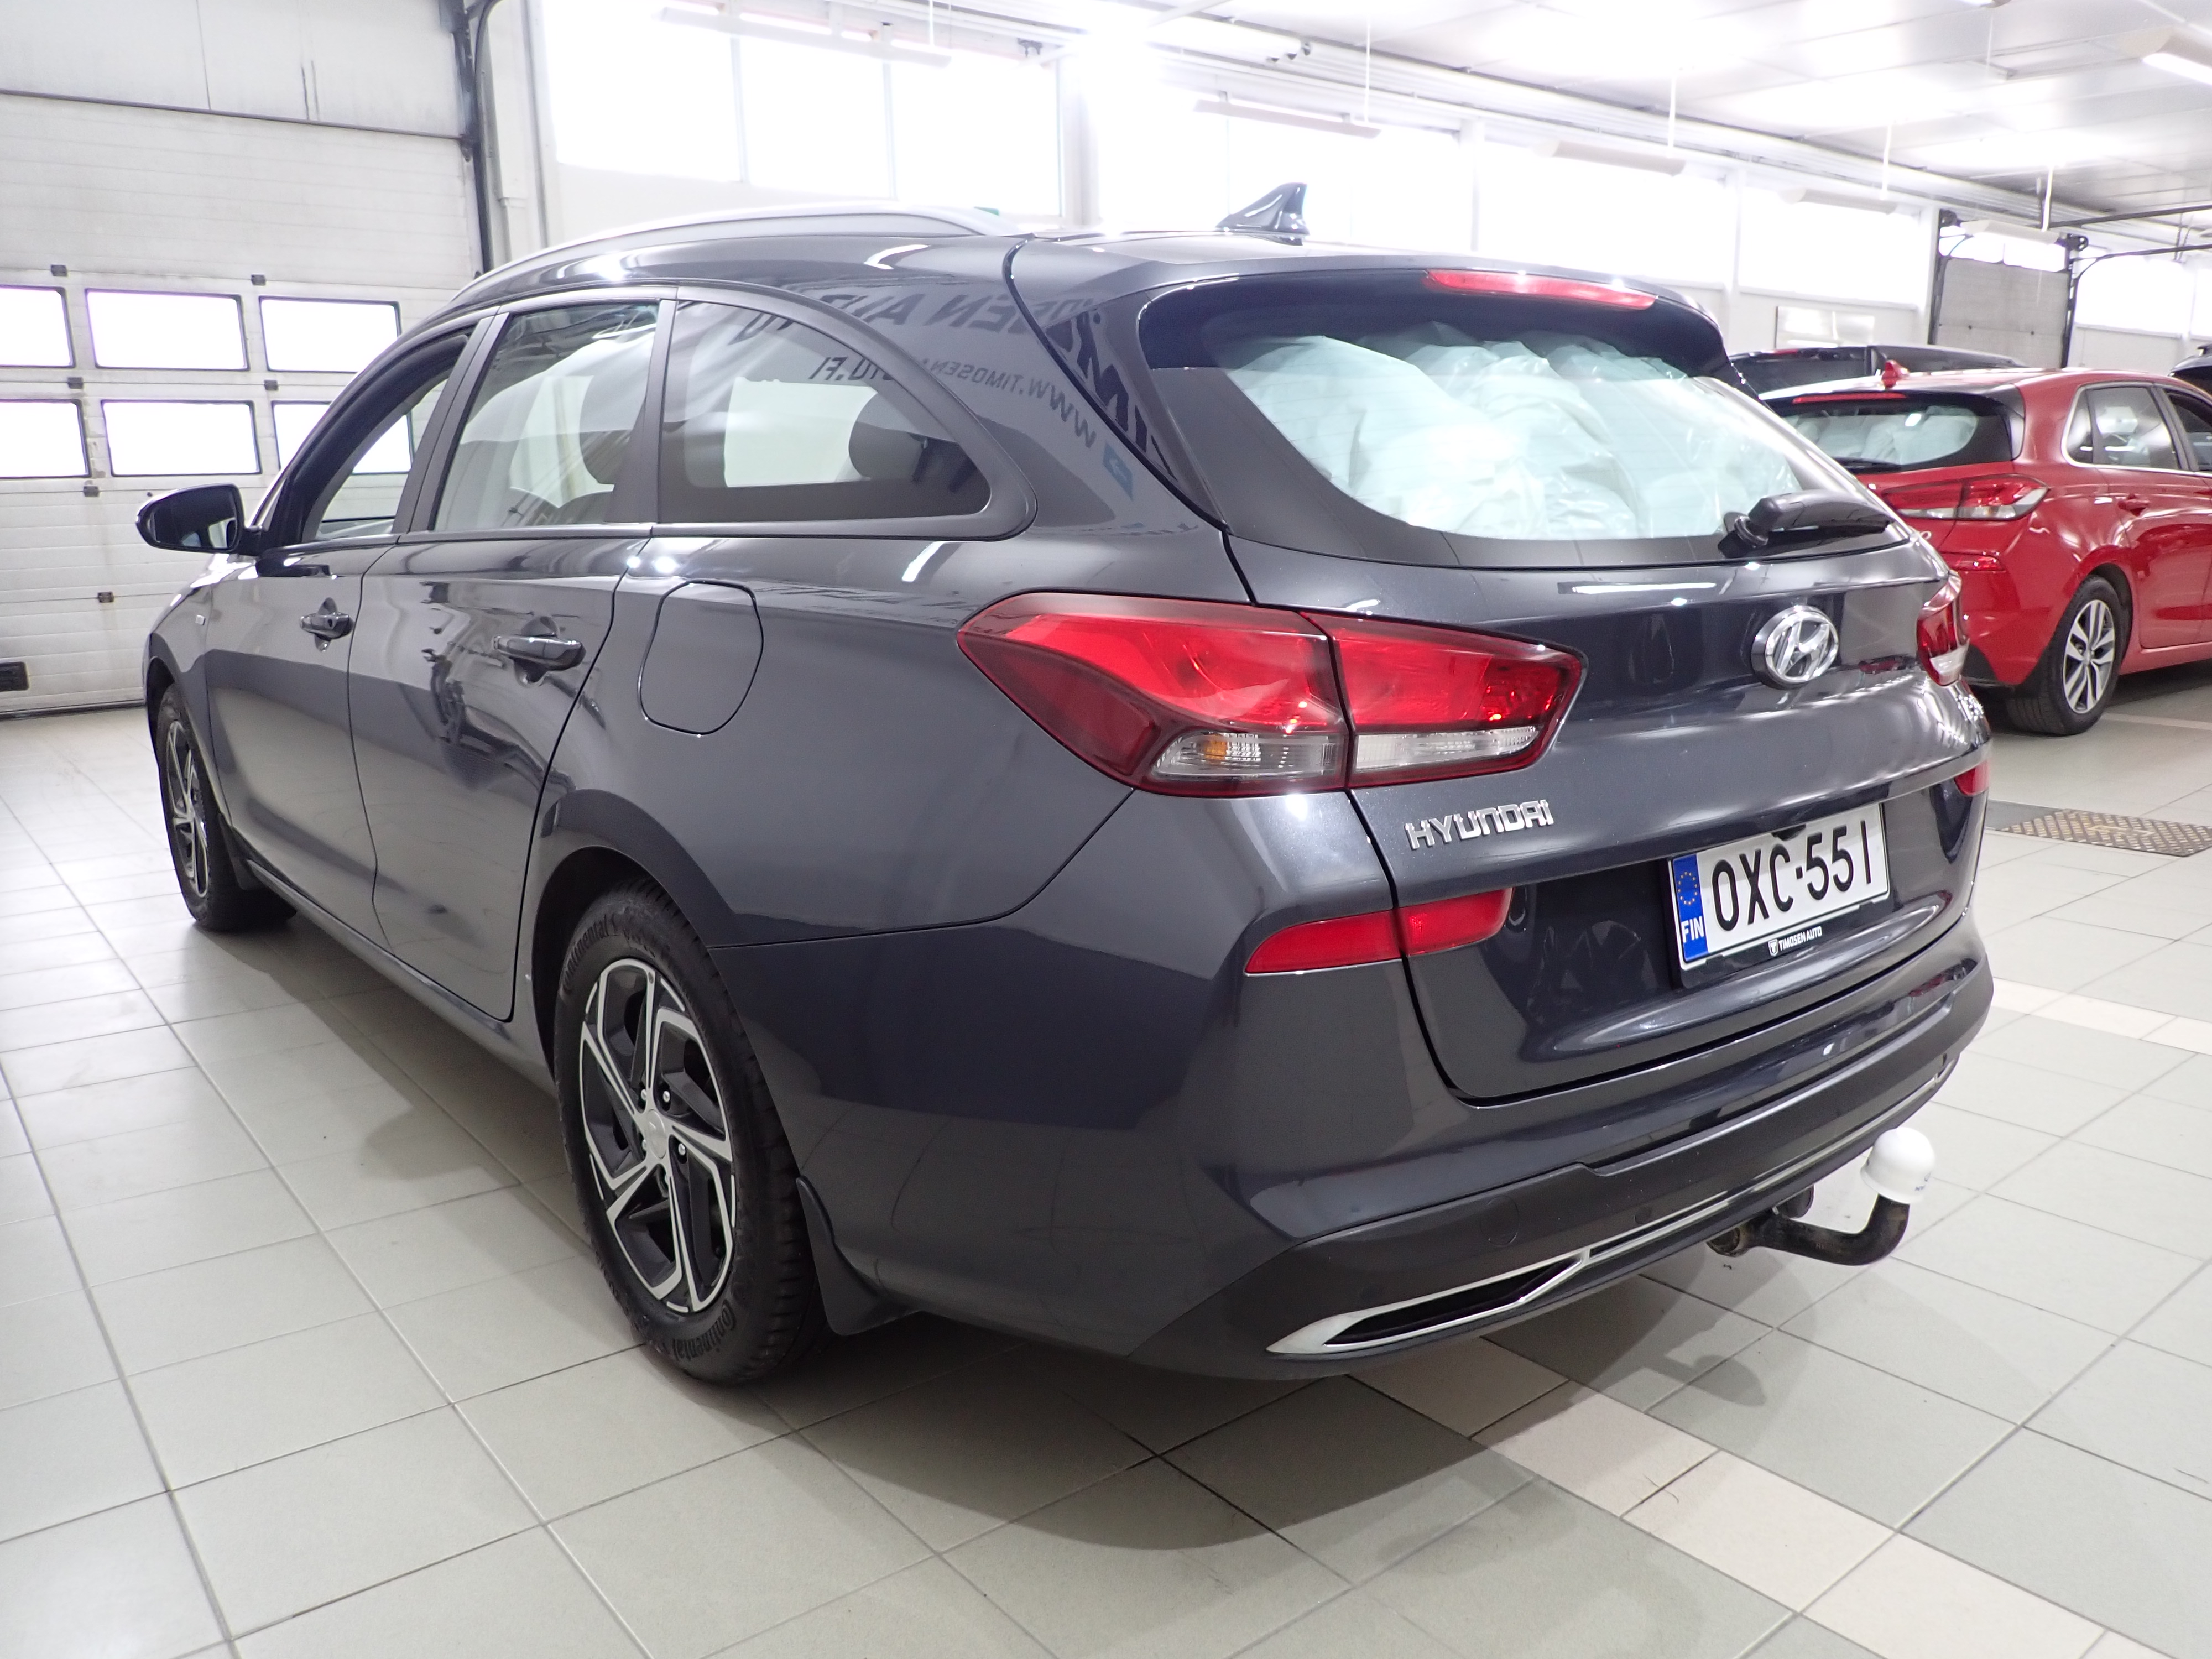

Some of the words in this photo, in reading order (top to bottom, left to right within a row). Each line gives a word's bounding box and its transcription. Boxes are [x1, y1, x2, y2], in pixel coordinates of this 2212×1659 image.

[1404, 799, 1554, 849] HYUNDAI
[1712, 821, 1871, 931] OXC-551
[1681, 916, 1704, 943] FIN
[1778, 932, 1806, 951] TIMOSEN
[1806, 926, 1822, 941] AUTO
[672, 1299, 737, 1361] Continental
